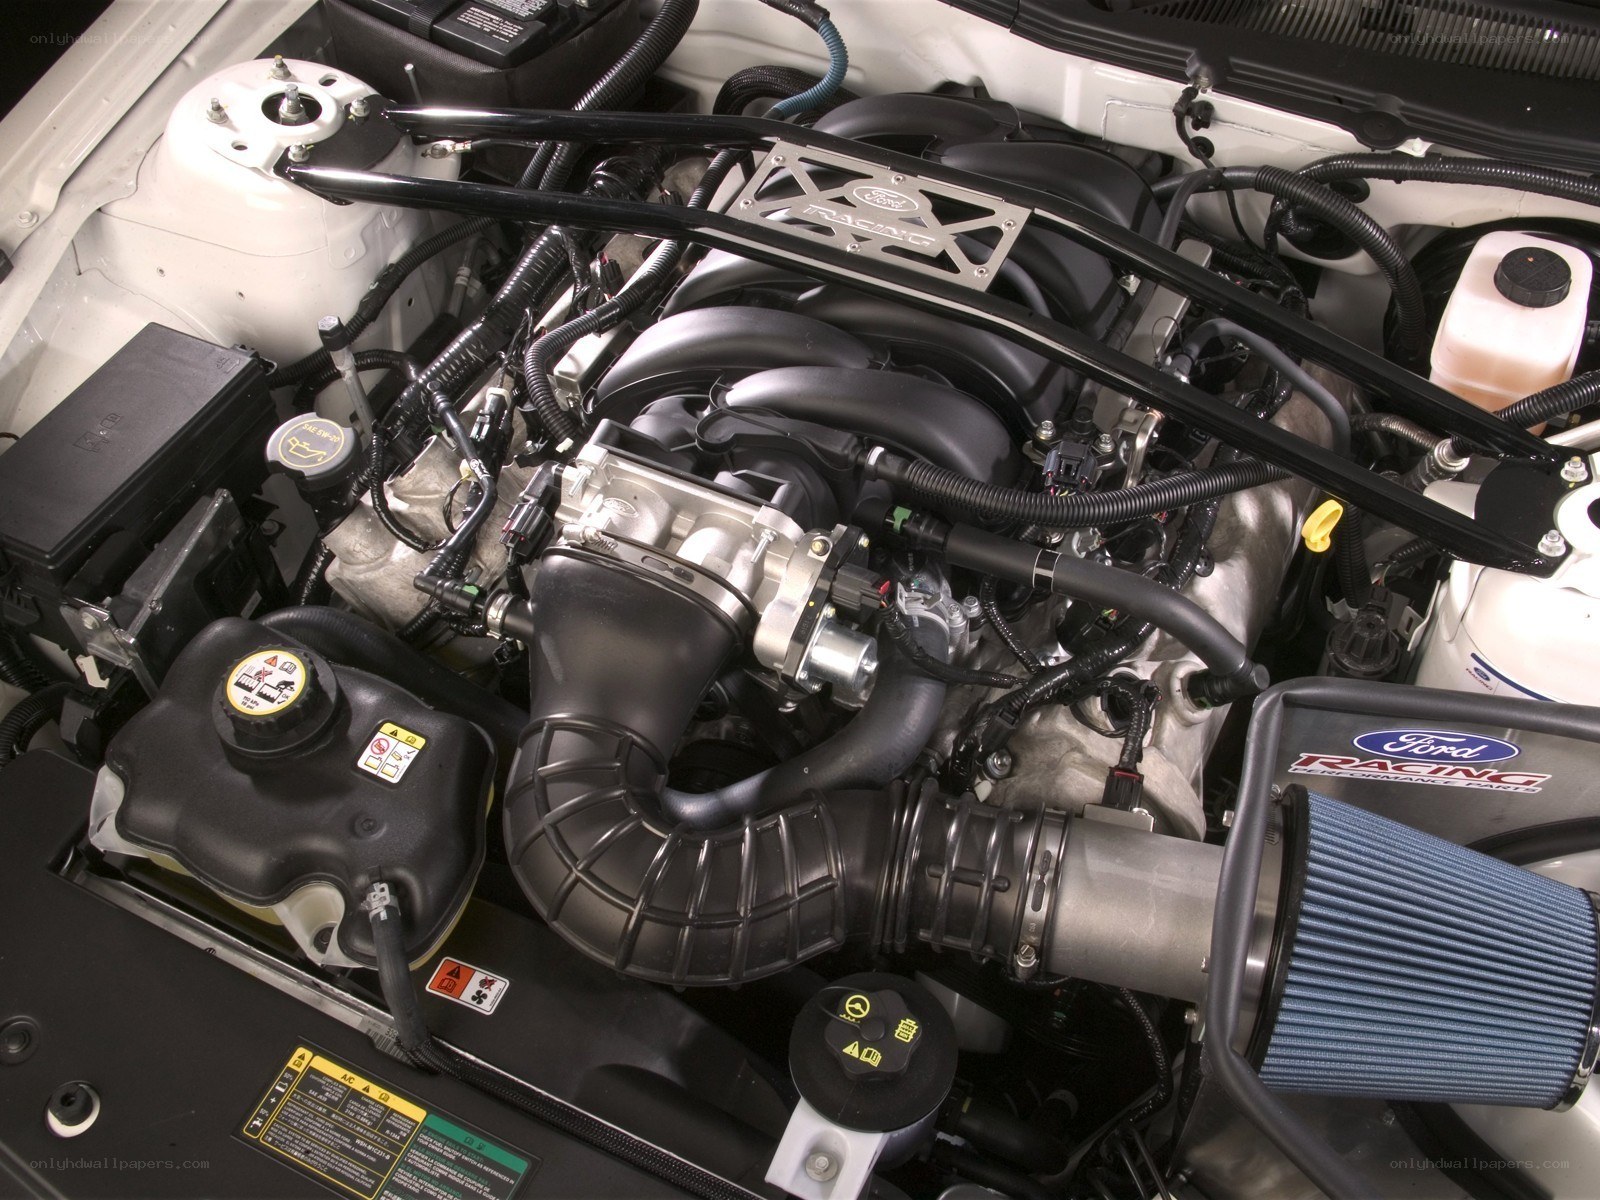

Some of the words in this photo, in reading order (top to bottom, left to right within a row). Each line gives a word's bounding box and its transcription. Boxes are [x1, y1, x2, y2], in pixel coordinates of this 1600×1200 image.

[864, 189, 904, 210] Ford
[802, 204, 936, 248] RACING
[302, 423, 318, 434] SAE
[317, 429, 340, 443] 5W-20
[1383, 732, 1482, 759] Ford
[1291, 768, 1457, 785] PERFORMANCE
[1465, 782, 1537, 793] PARTS
[1294, 754, 1549, 787] RACING
[340, 1072, 356, 1084] A/C
